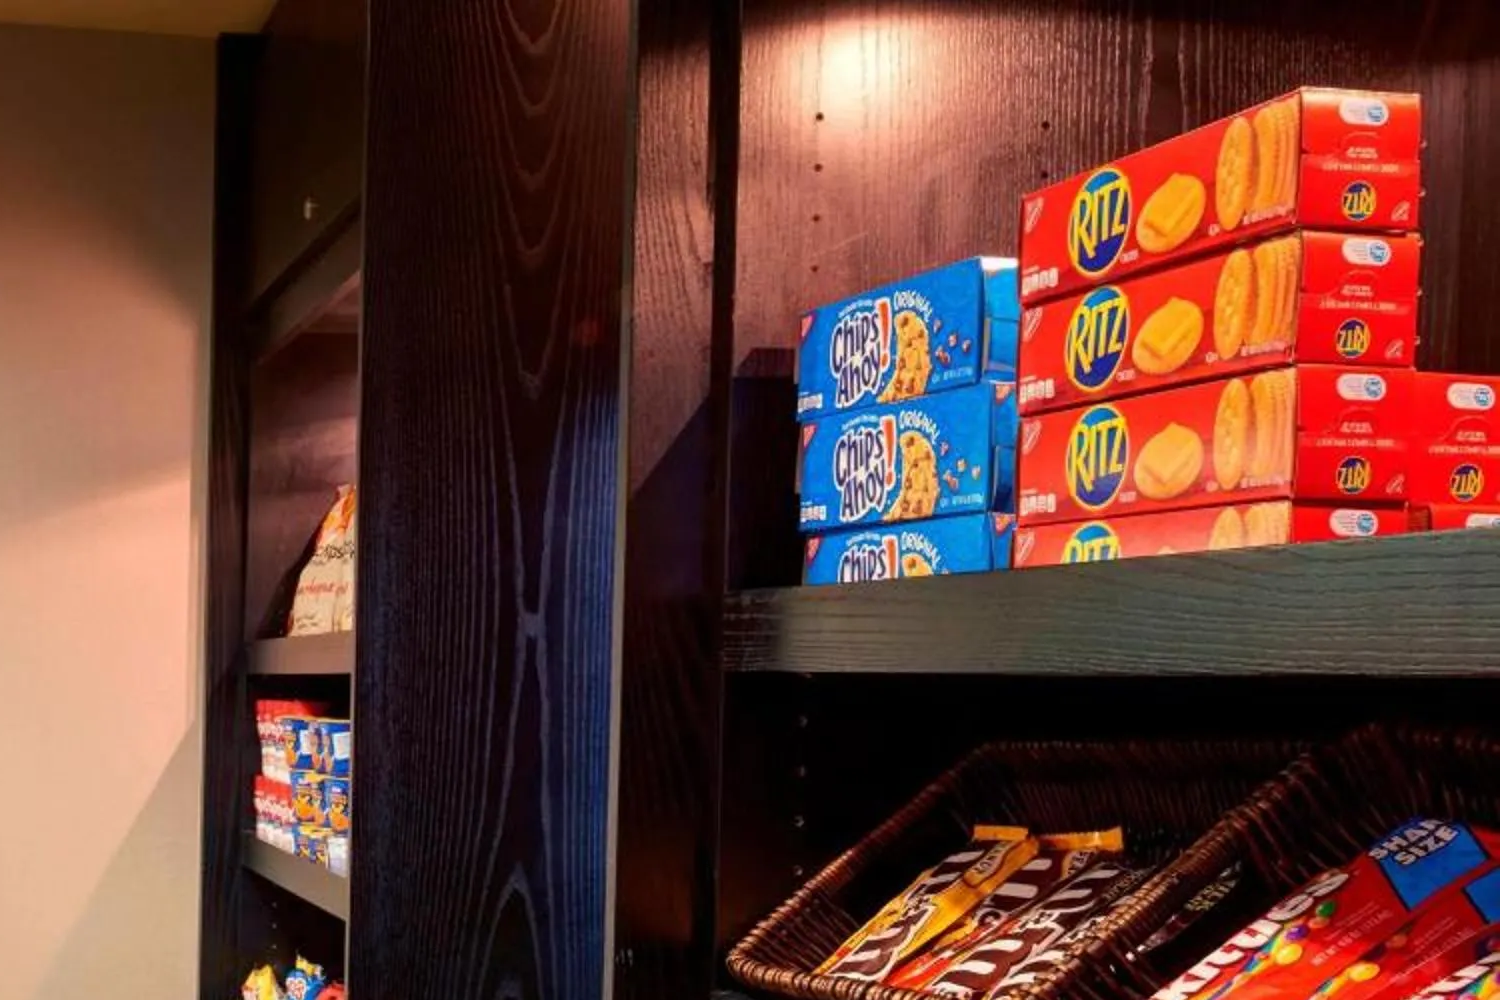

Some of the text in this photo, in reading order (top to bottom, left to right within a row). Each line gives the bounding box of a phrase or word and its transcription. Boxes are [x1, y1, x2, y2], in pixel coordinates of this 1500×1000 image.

[1072, 177, 1128, 260] RITZ
[1068, 296, 1127, 375] RITZ
[1070, 416, 1126, 493] RITZ
[1394, 825, 1459, 865] SIZE
